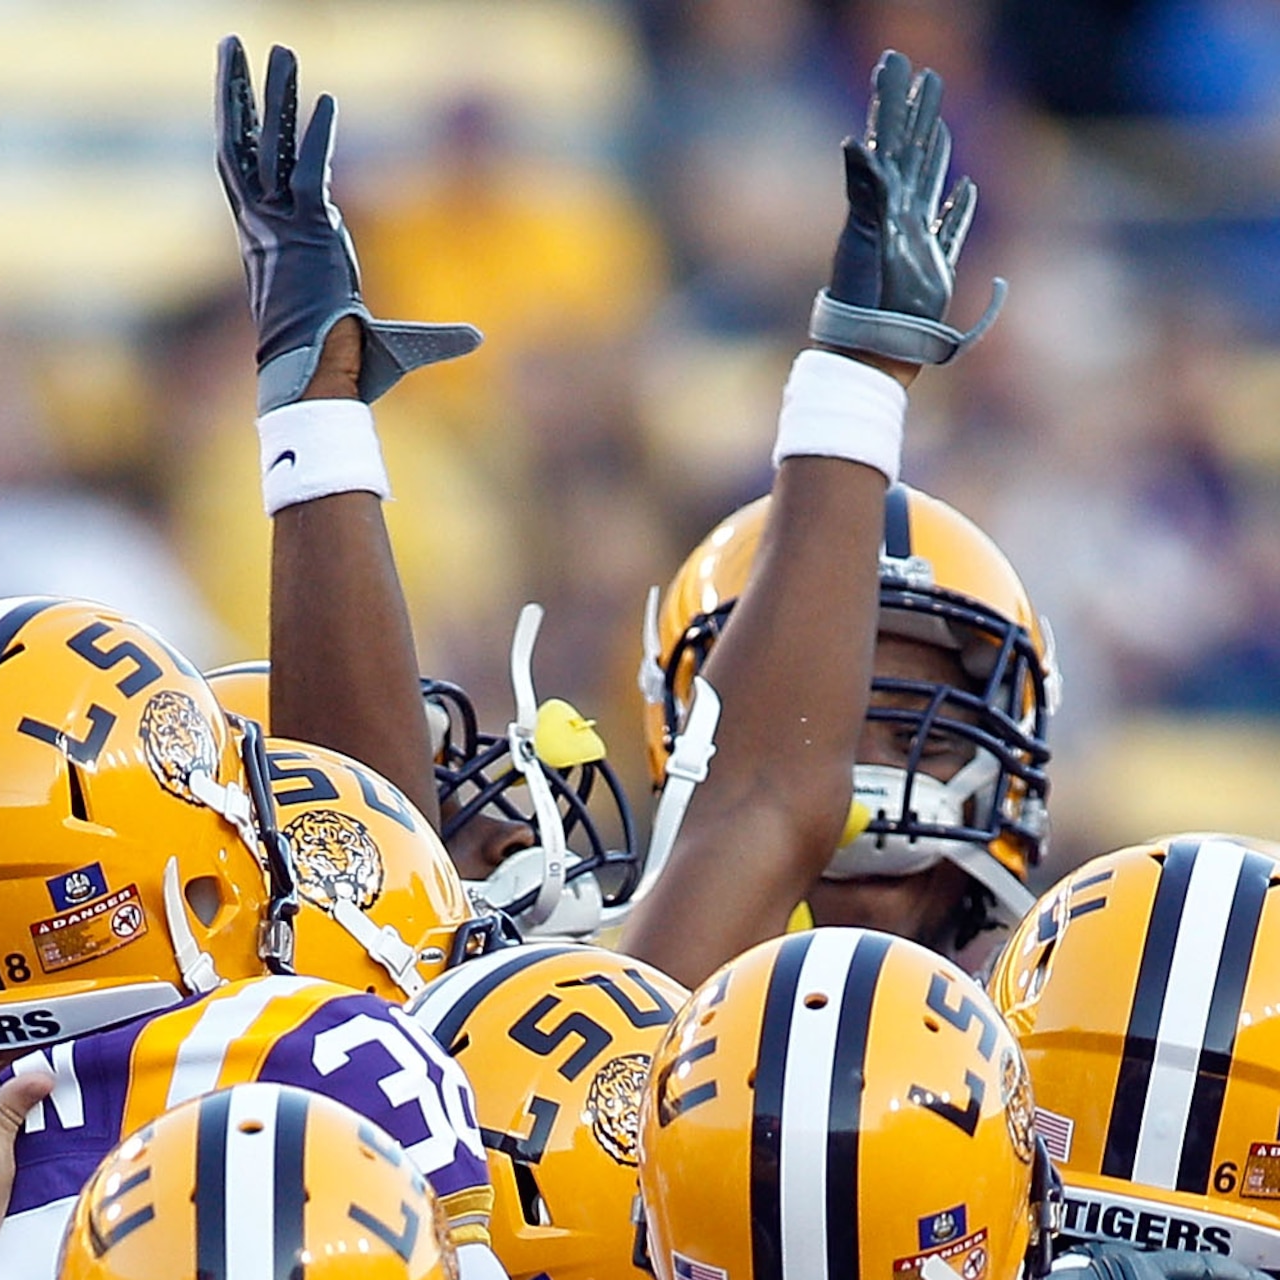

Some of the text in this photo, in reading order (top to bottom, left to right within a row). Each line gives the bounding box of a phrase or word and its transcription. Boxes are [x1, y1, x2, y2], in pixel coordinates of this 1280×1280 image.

[52, 889, 131, 930] DANGER
[4, 953, 31, 983] 8
[1213, 1161, 1238, 1194] 6
[1062, 1199, 1232, 1257] TIGERS
